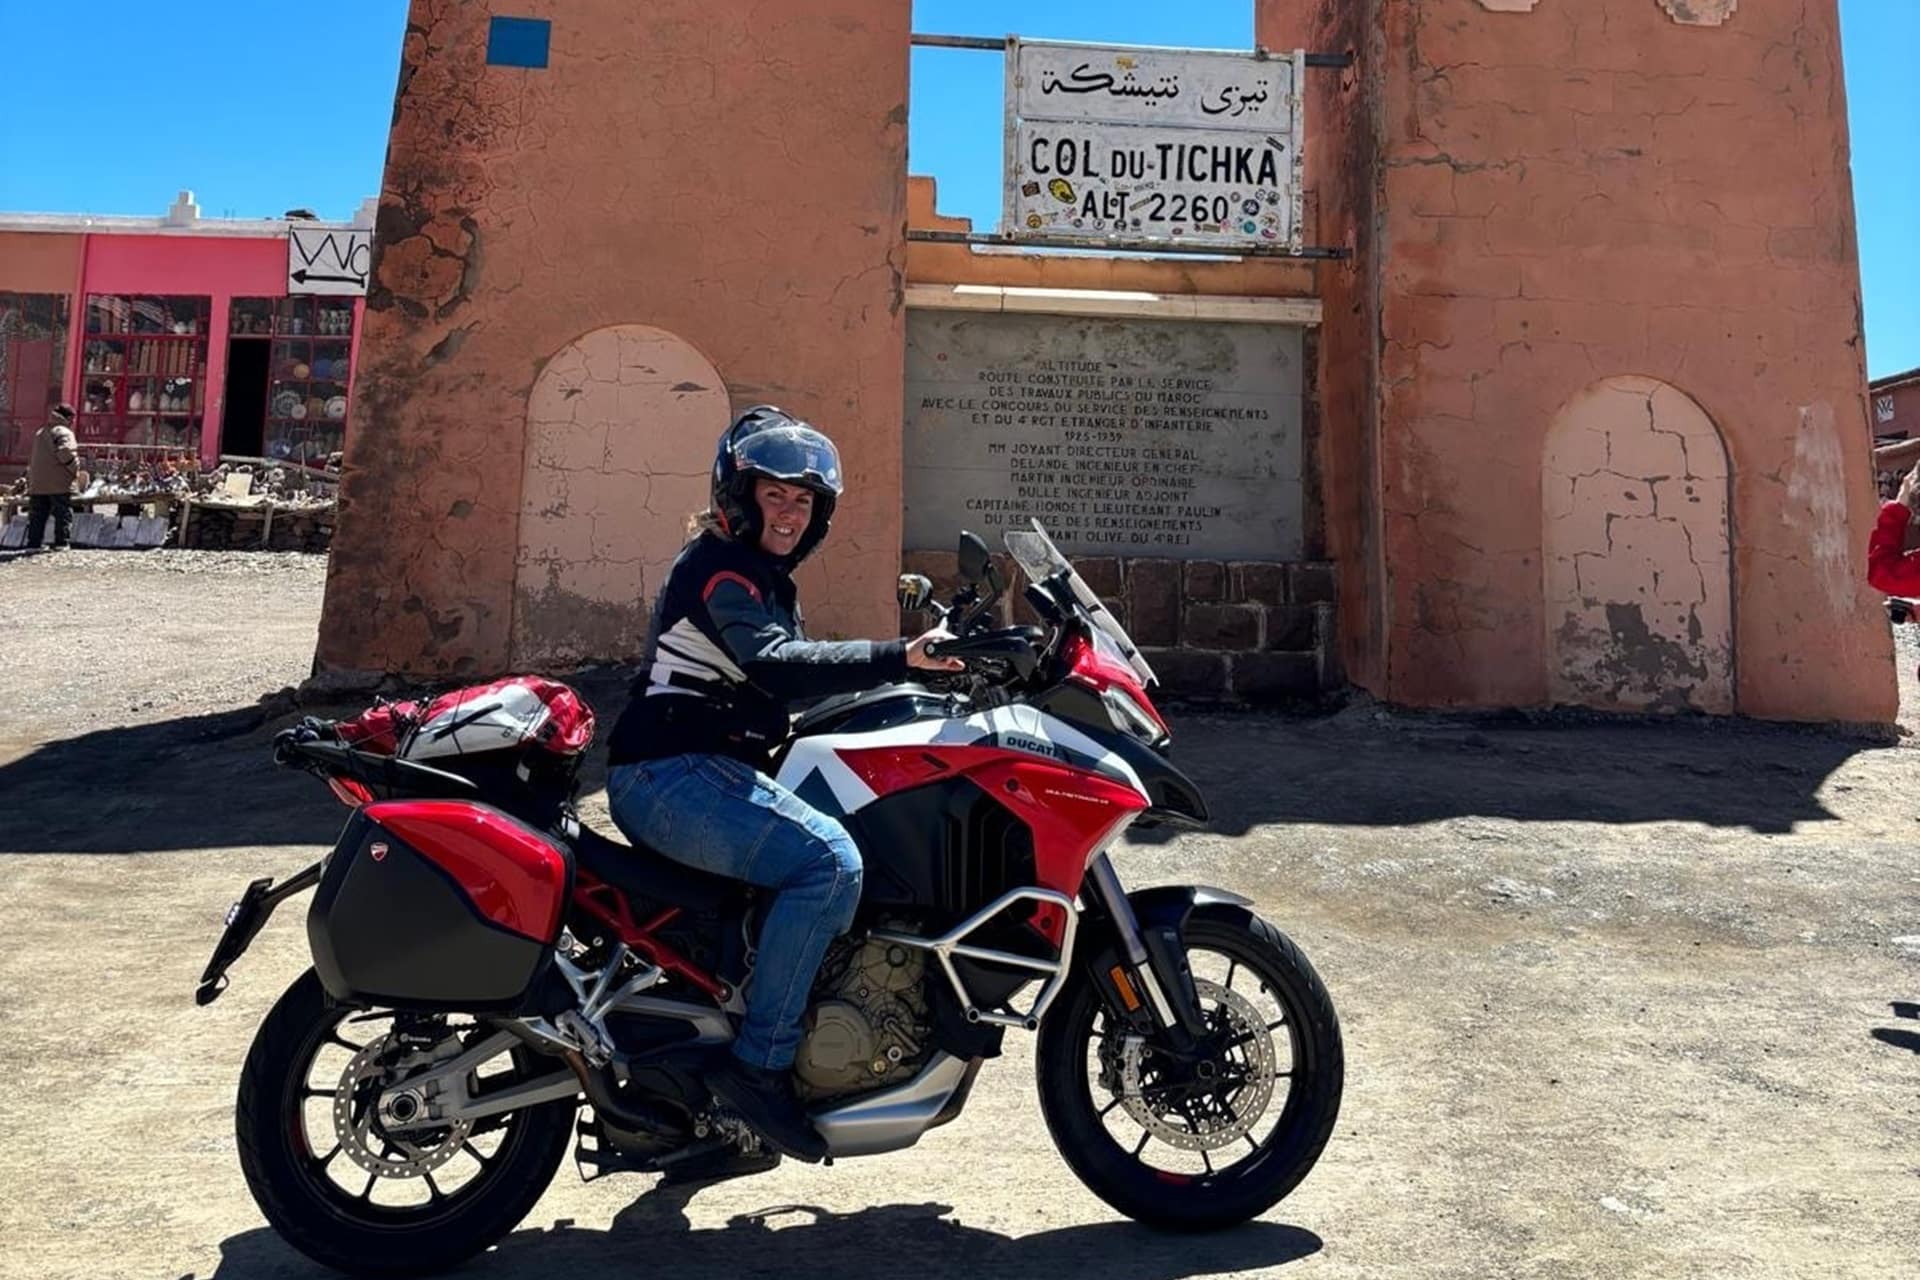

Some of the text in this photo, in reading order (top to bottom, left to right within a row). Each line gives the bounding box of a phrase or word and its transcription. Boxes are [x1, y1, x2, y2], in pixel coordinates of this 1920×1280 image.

[1031, 138, 1099, 177] COL
[1081, 190, 1130, 219] ALT
[1148, 193, 1229, 223] 2260
[292, 231, 369, 277] WC
[1161, 378, 1212, 390] SERVICE
[989, 386, 1202, 404] DES TRAVAUX PUBLICS DU MAROC
[921, 398, 1269, 420] AVEC LE CONCOURS DU SERVICE DES RENSEIGNEMENTS
[972, 413, 988, 424] ET
[994, 413, 1012, 425] DU
[1061, 416, 1126, 429] ETRANGER
[1011, 444, 1061, 455] JOYANT
[1067, 446, 1137, 458] DIRECTEUR
[1142, 448, 1199, 460] GENERAL
[1075, 460, 1139, 472] INGENIEUR
[1143, 462, 1160, 473] EN
[1010, 472, 1054, 483] MARTIN
[966, 499, 1029, 511] CAPITAINE
[984, 513, 1003, 525] DU
[1066, 516, 1090, 527] DES
[1095, 517, 1203, 531] RENSEIGNEMENTS
[1130, 533, 1149, 544] DU
